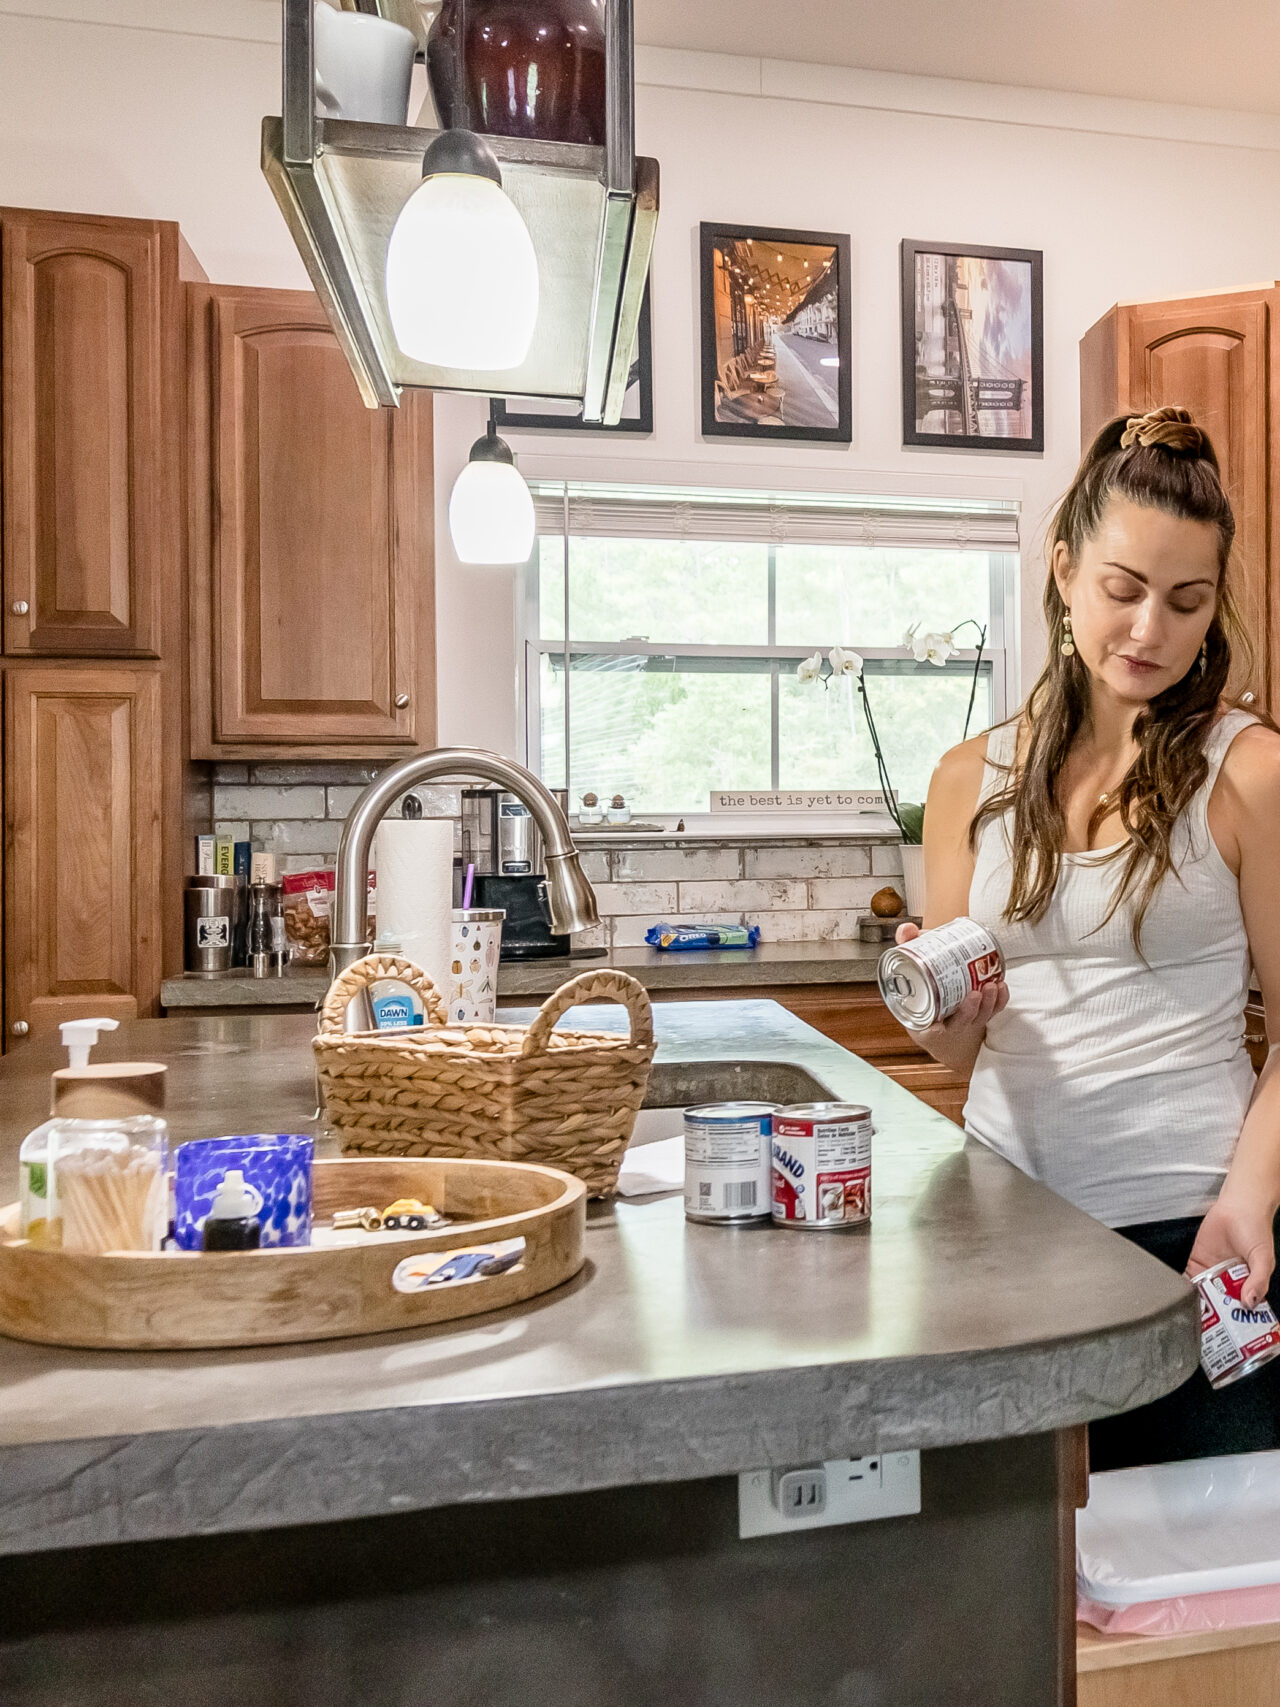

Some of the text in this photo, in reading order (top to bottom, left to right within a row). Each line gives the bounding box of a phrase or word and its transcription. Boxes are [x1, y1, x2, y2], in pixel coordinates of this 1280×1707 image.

[720, 795, 745, 806] the
[750, 795, 782, 806] best
[787, 795, 803, 806] is
[807, 794, 832, 808] yet
[837, 794, 853, 805] to
[380, 1008, 408, 1018] DAWN
